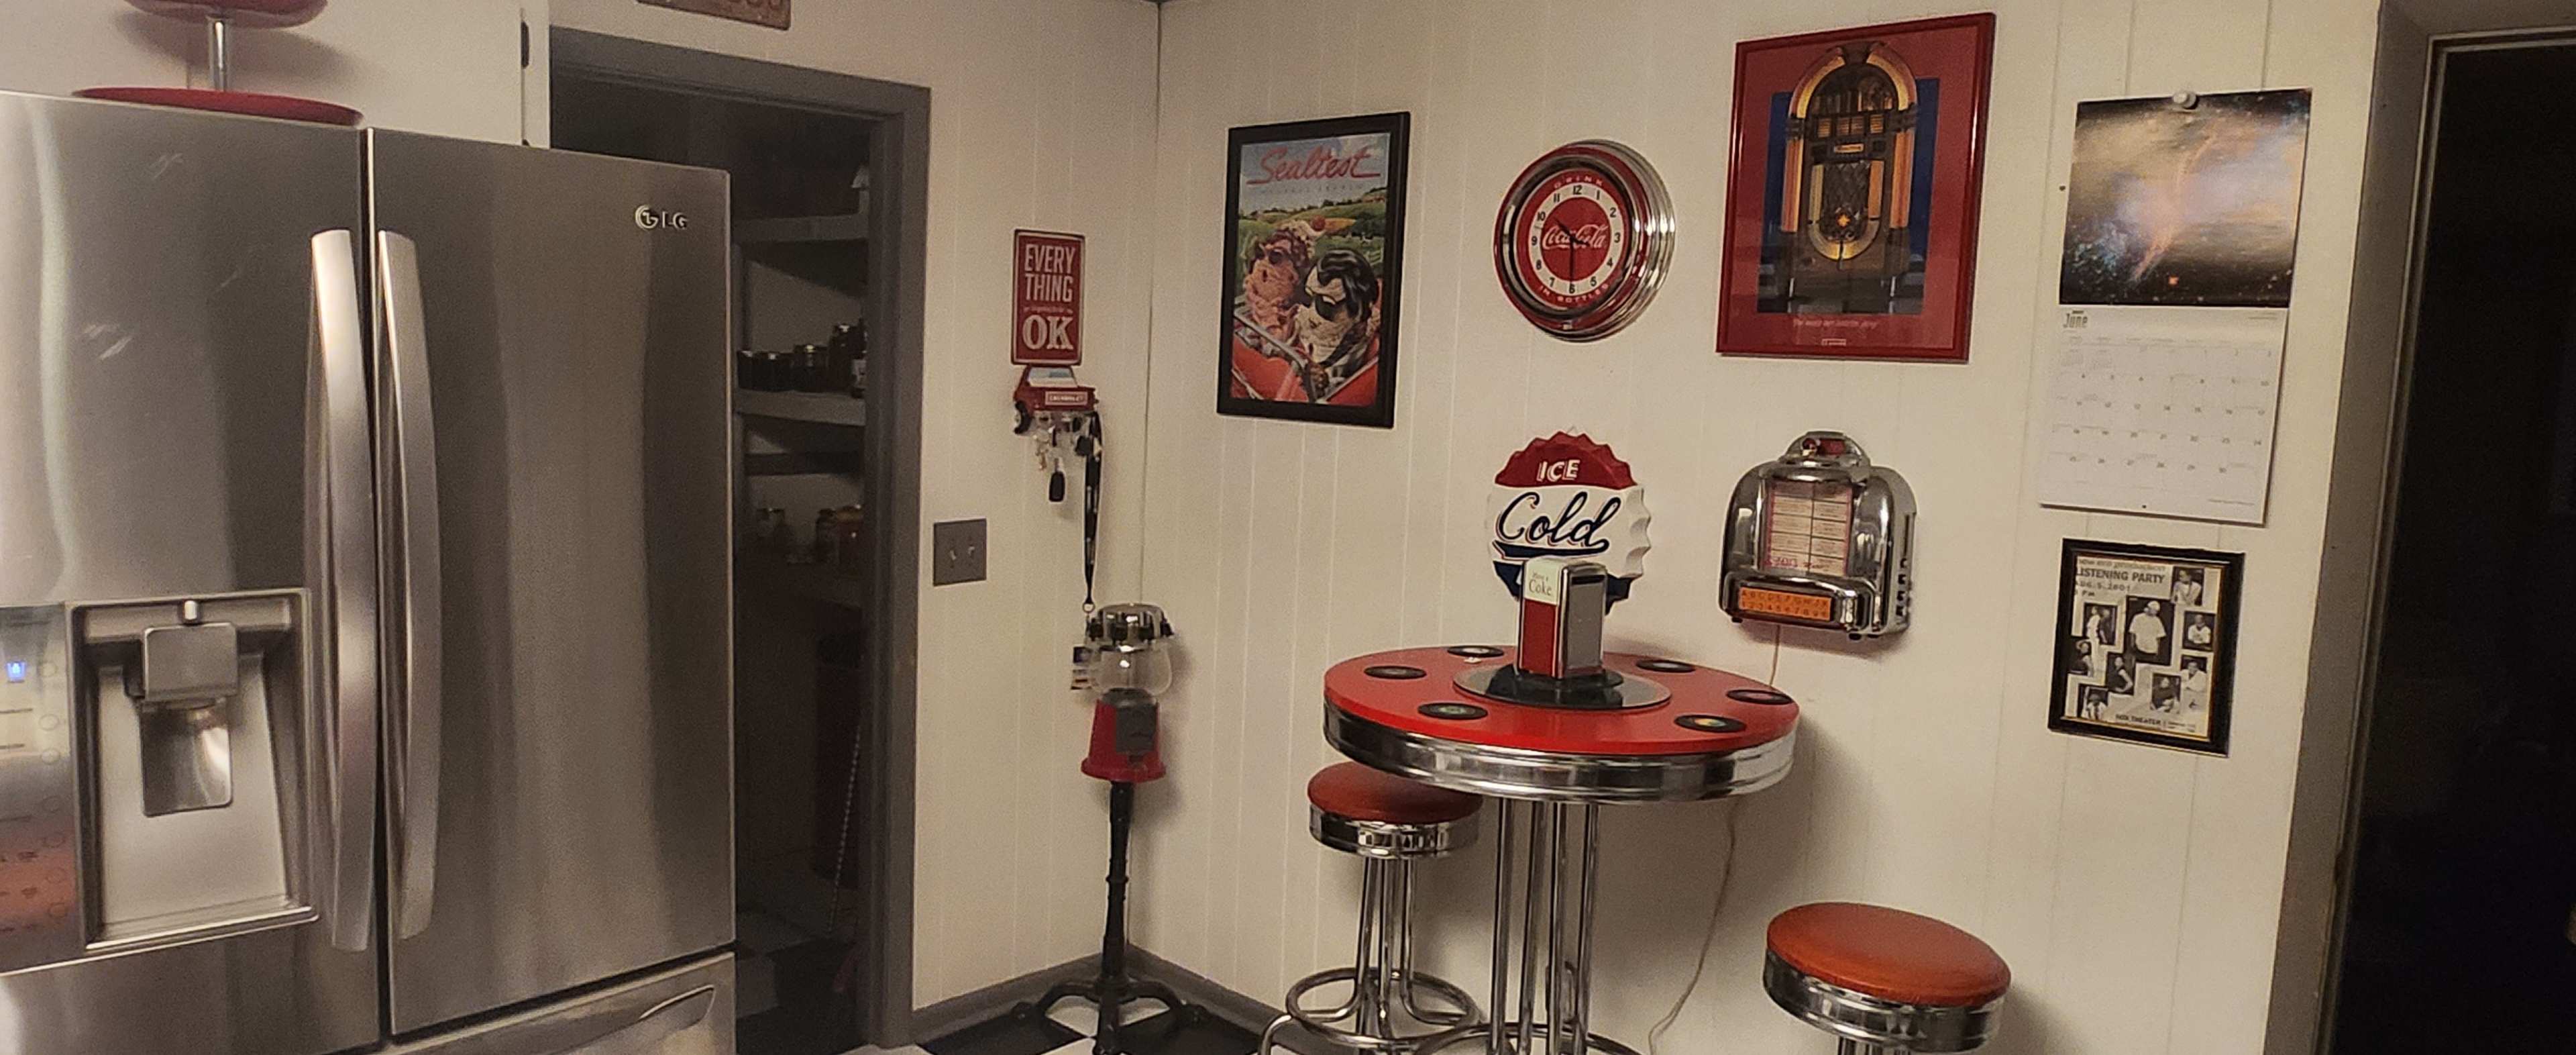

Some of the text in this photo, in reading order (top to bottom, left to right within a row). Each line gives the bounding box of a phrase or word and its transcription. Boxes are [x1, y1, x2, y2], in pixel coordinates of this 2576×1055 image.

[1248, 146, 1380, 185] Sealtest
[1554, 175, 1603, 189] DRINK
[1573, 185, 1582, 195] 12
[1597, 190, 1600, 199] 1
[1554, 193, 1560, 201] 11
[1537, 211, 1546, 221] 10
[1610, 207, 1616, 217] 2
[1532, 236, 1538, 246] 9
[1614, 232, 1621, 243] 3
[1024, 244, 1075, 274] EVERY
[1607, 258, 1613, 268] 4
[1536, 260, 1542, 270] 8
[1549, 277, 1555, 287] 7
[1590, 276, 1597, 287] 5
[1024, 273, 1073, 303] THING
[1568, 284, 1575, 294] 6
[2063, 313, 2088, 328] June
[1022, 314, 1074, 350] OK
[1536, 459, 1580, 482] ICE
[1495, 491, 1621, 555] Cold
[2132, 571, 2165, 583] PARTY
[1529, 579, 1552, 596] Coke
